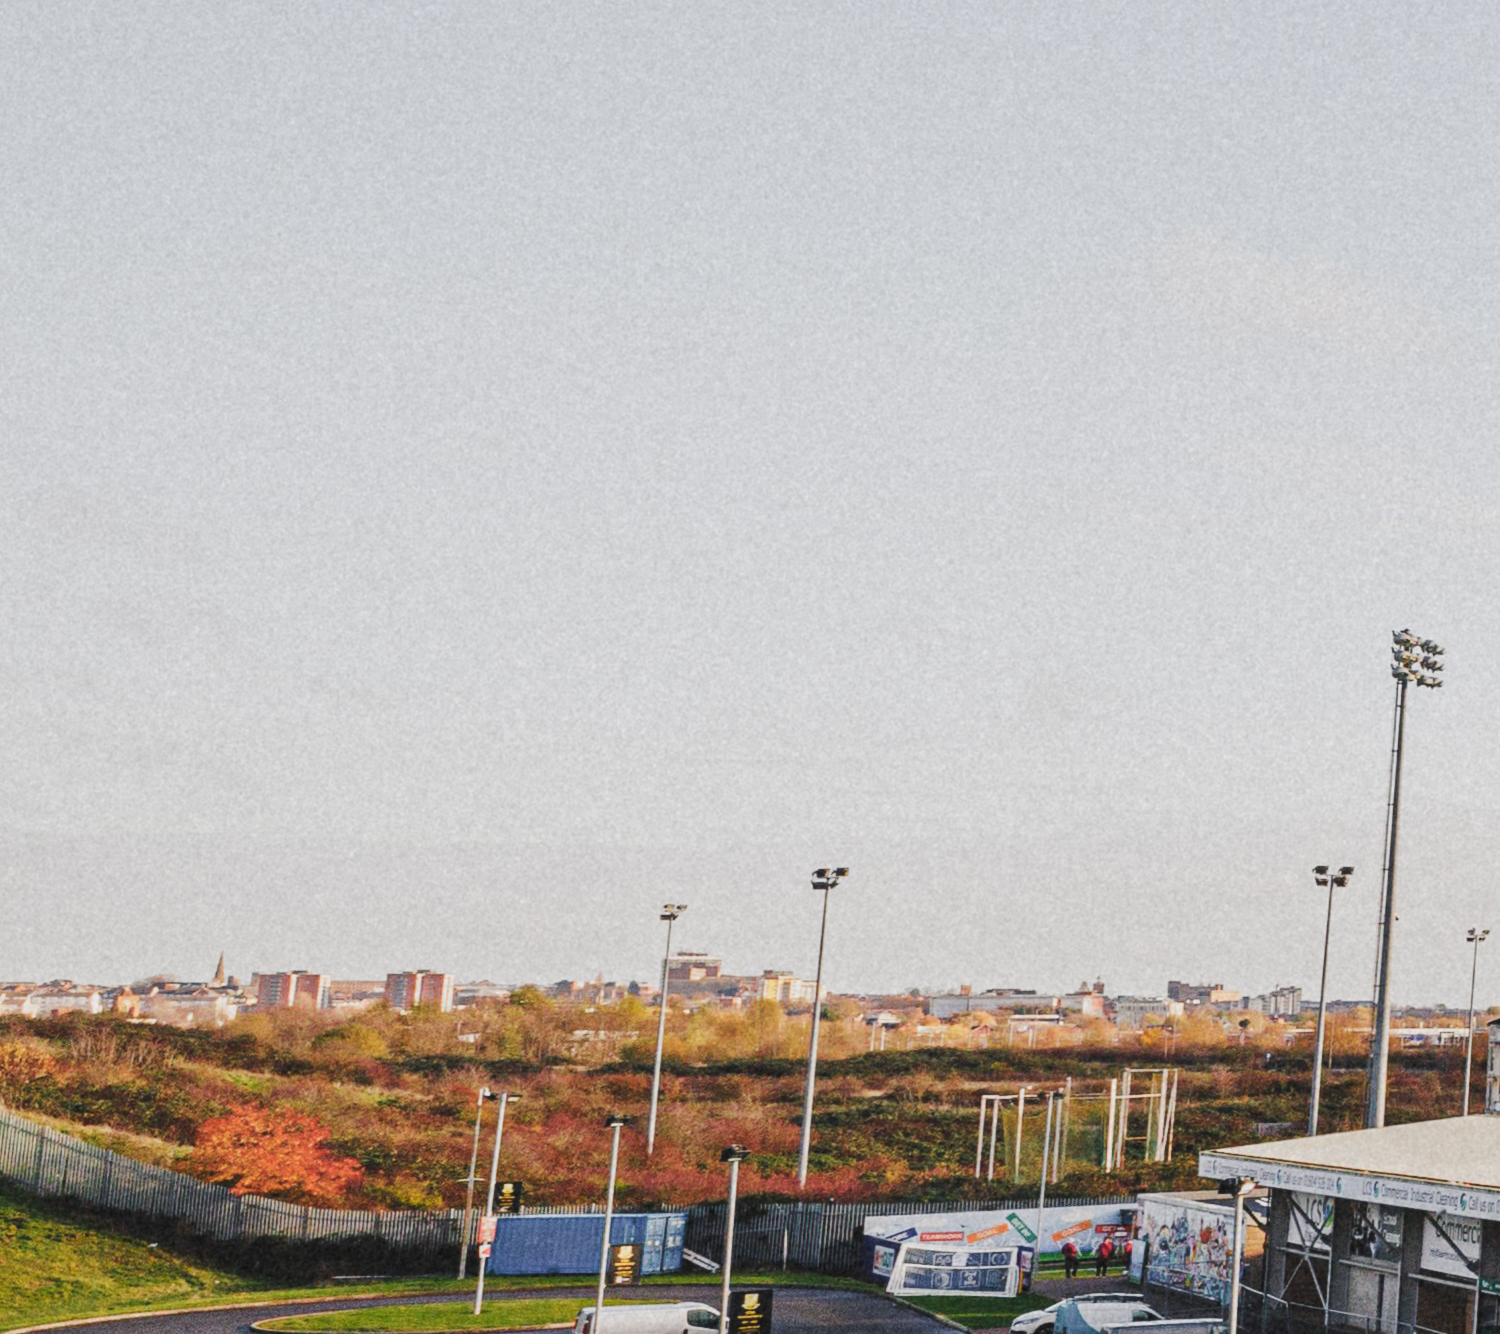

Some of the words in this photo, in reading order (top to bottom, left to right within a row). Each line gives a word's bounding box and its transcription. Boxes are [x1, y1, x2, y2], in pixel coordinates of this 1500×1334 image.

[1362, 1181, 1373, 1196] LCS
[1436, 1191, 1458, 1210] Cleaning
[1469, 1196, 1479, 1211] Call
